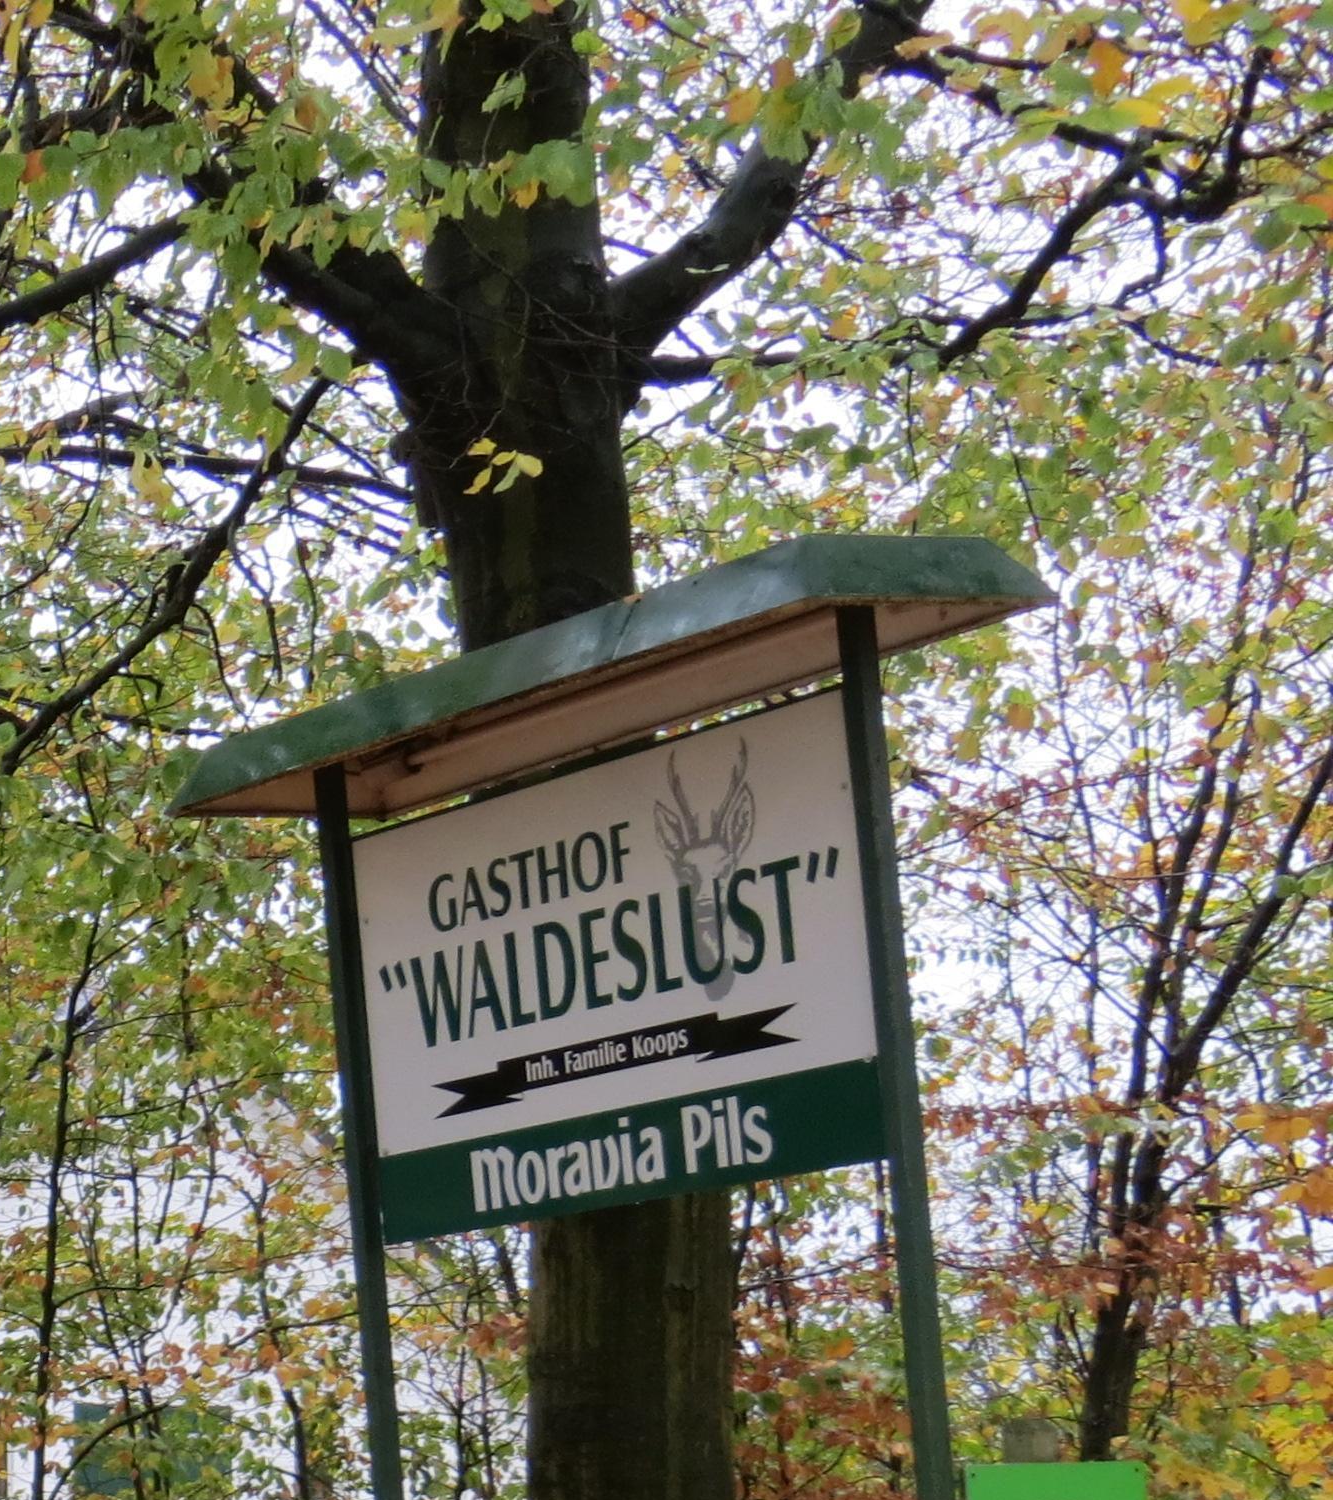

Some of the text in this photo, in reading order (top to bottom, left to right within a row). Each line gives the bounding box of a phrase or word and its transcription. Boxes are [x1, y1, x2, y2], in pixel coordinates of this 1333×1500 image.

[428, 821, 631, 932] GASTHOF
[525, 1028, 689, 1082] Inh. Familie Koops
[679, 1095, 774, 1175] Pils
